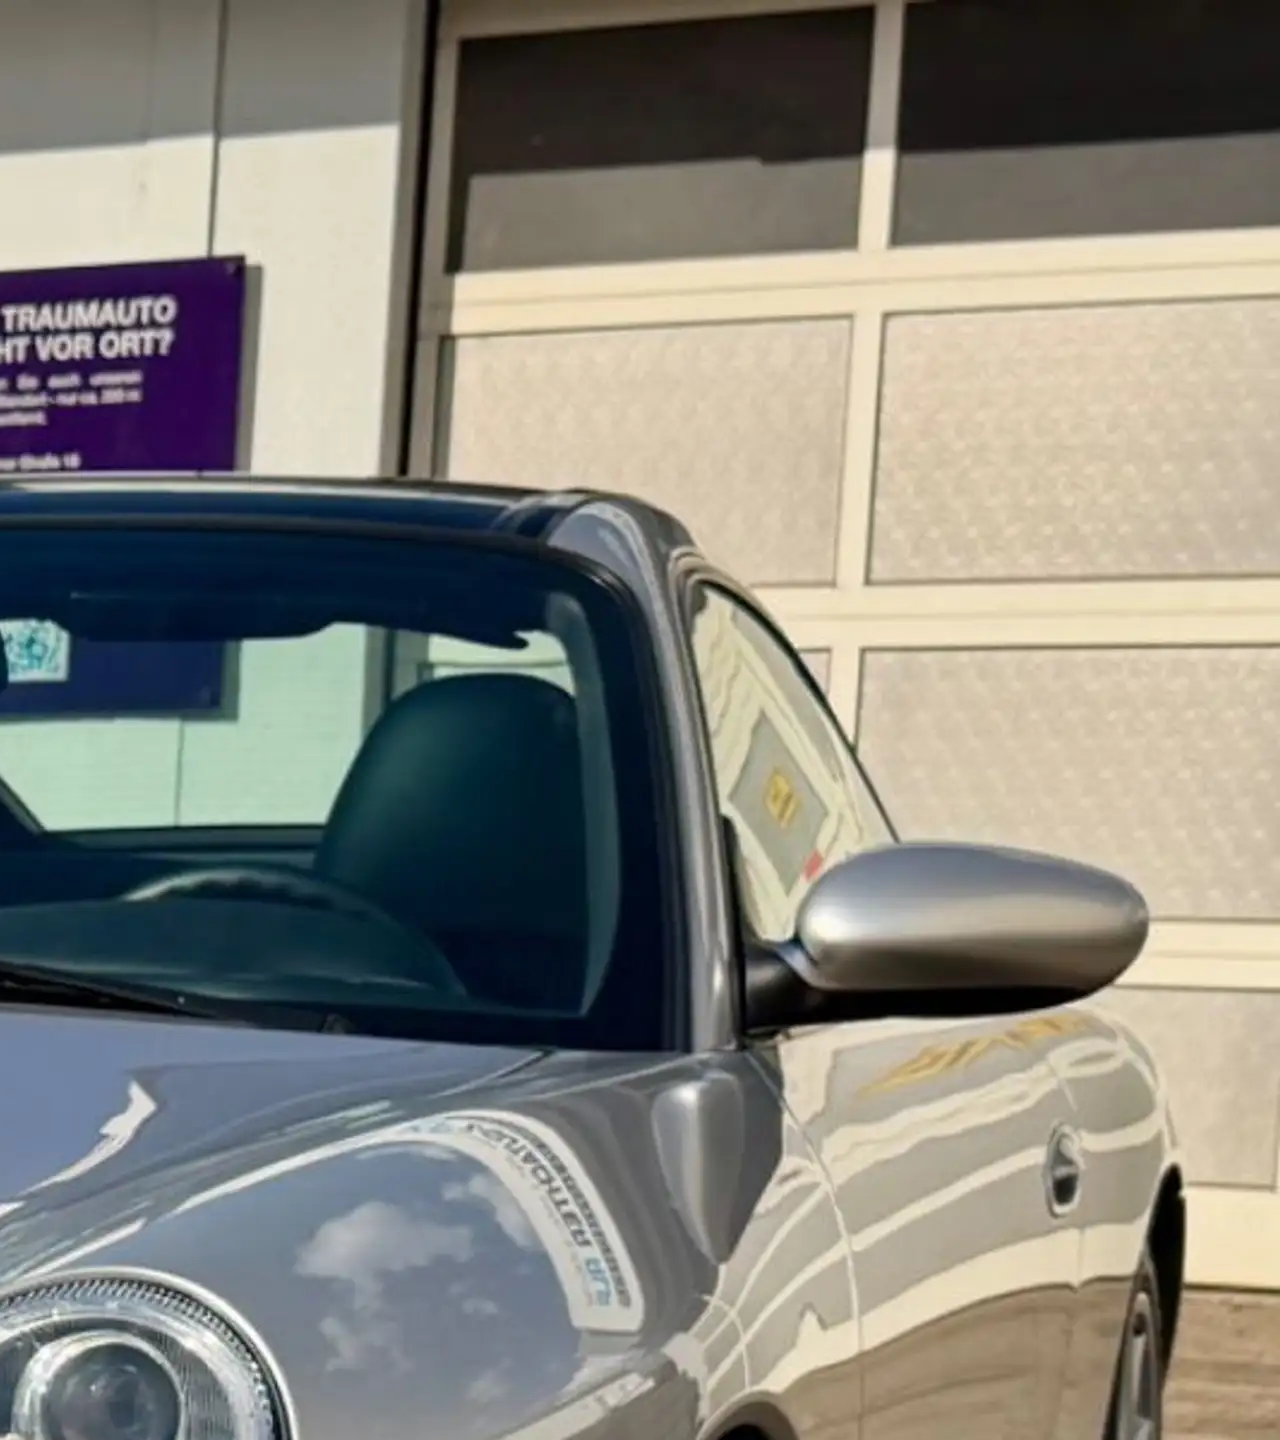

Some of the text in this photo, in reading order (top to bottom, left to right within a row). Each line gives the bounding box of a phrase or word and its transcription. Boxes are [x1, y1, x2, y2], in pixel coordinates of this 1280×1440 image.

[0, 294, 178, 332] TRAUMAUTO
[34, 331, 95, 362] VOR
[98, 328, 175, 359] ORT?
